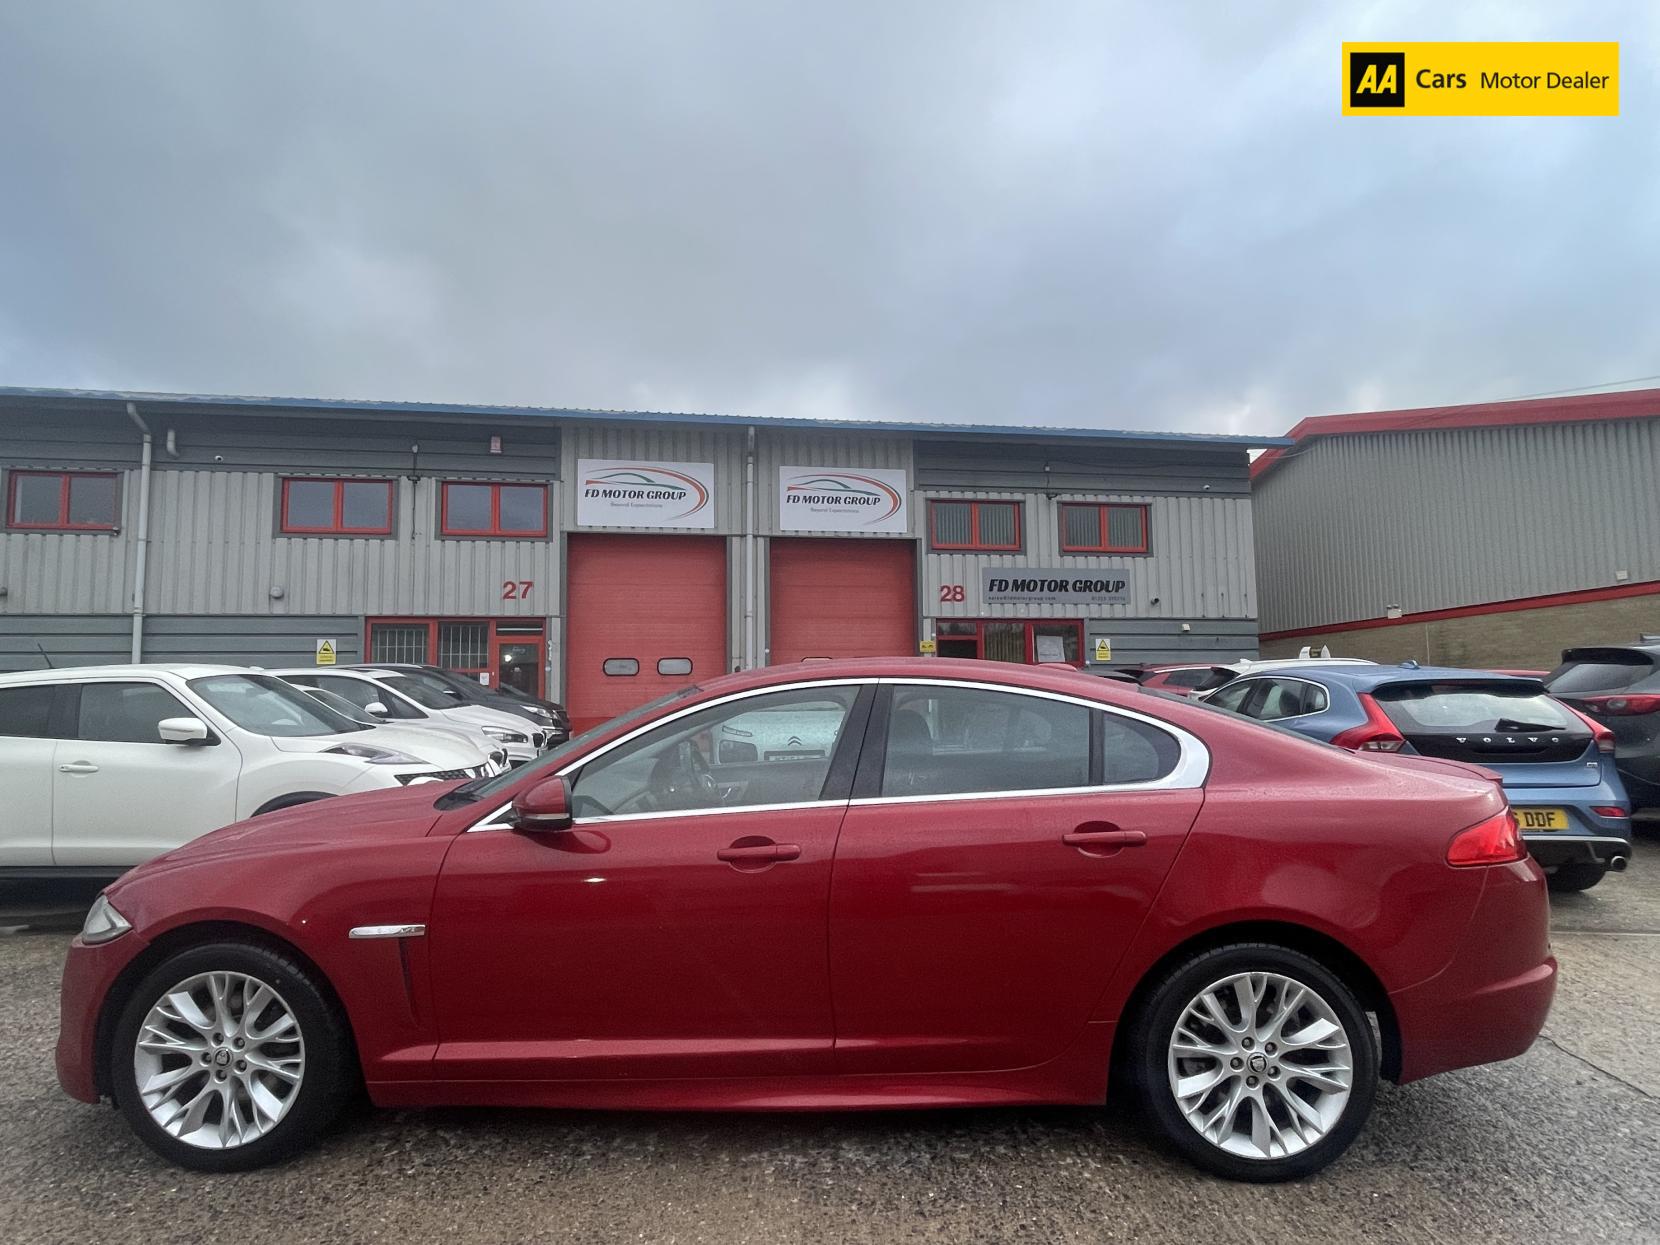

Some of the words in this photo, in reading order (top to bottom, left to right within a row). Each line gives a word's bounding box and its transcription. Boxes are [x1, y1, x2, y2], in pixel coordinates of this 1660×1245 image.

[584, 488, 600, 498] FD
[601, 489, 645, 500] MOTOR
[646, 490, 687, 500] GROUP
[786, 494, 800, 504] FD
[801, 495, 842, 505] MOTOR
[844, 496, 881, 506] GROUP
[502, 581, 534, 600] 27
[988, 578, 1009, 592] FD
[1011, 579, 1069, 593] MOTOR
[1072, 579, 1126, 593] GROUP
[940, 585, 965, 602] 28
[1456, 736, 1559, 744] VOLVO
[1524, 811, 1556, 827] DDF
